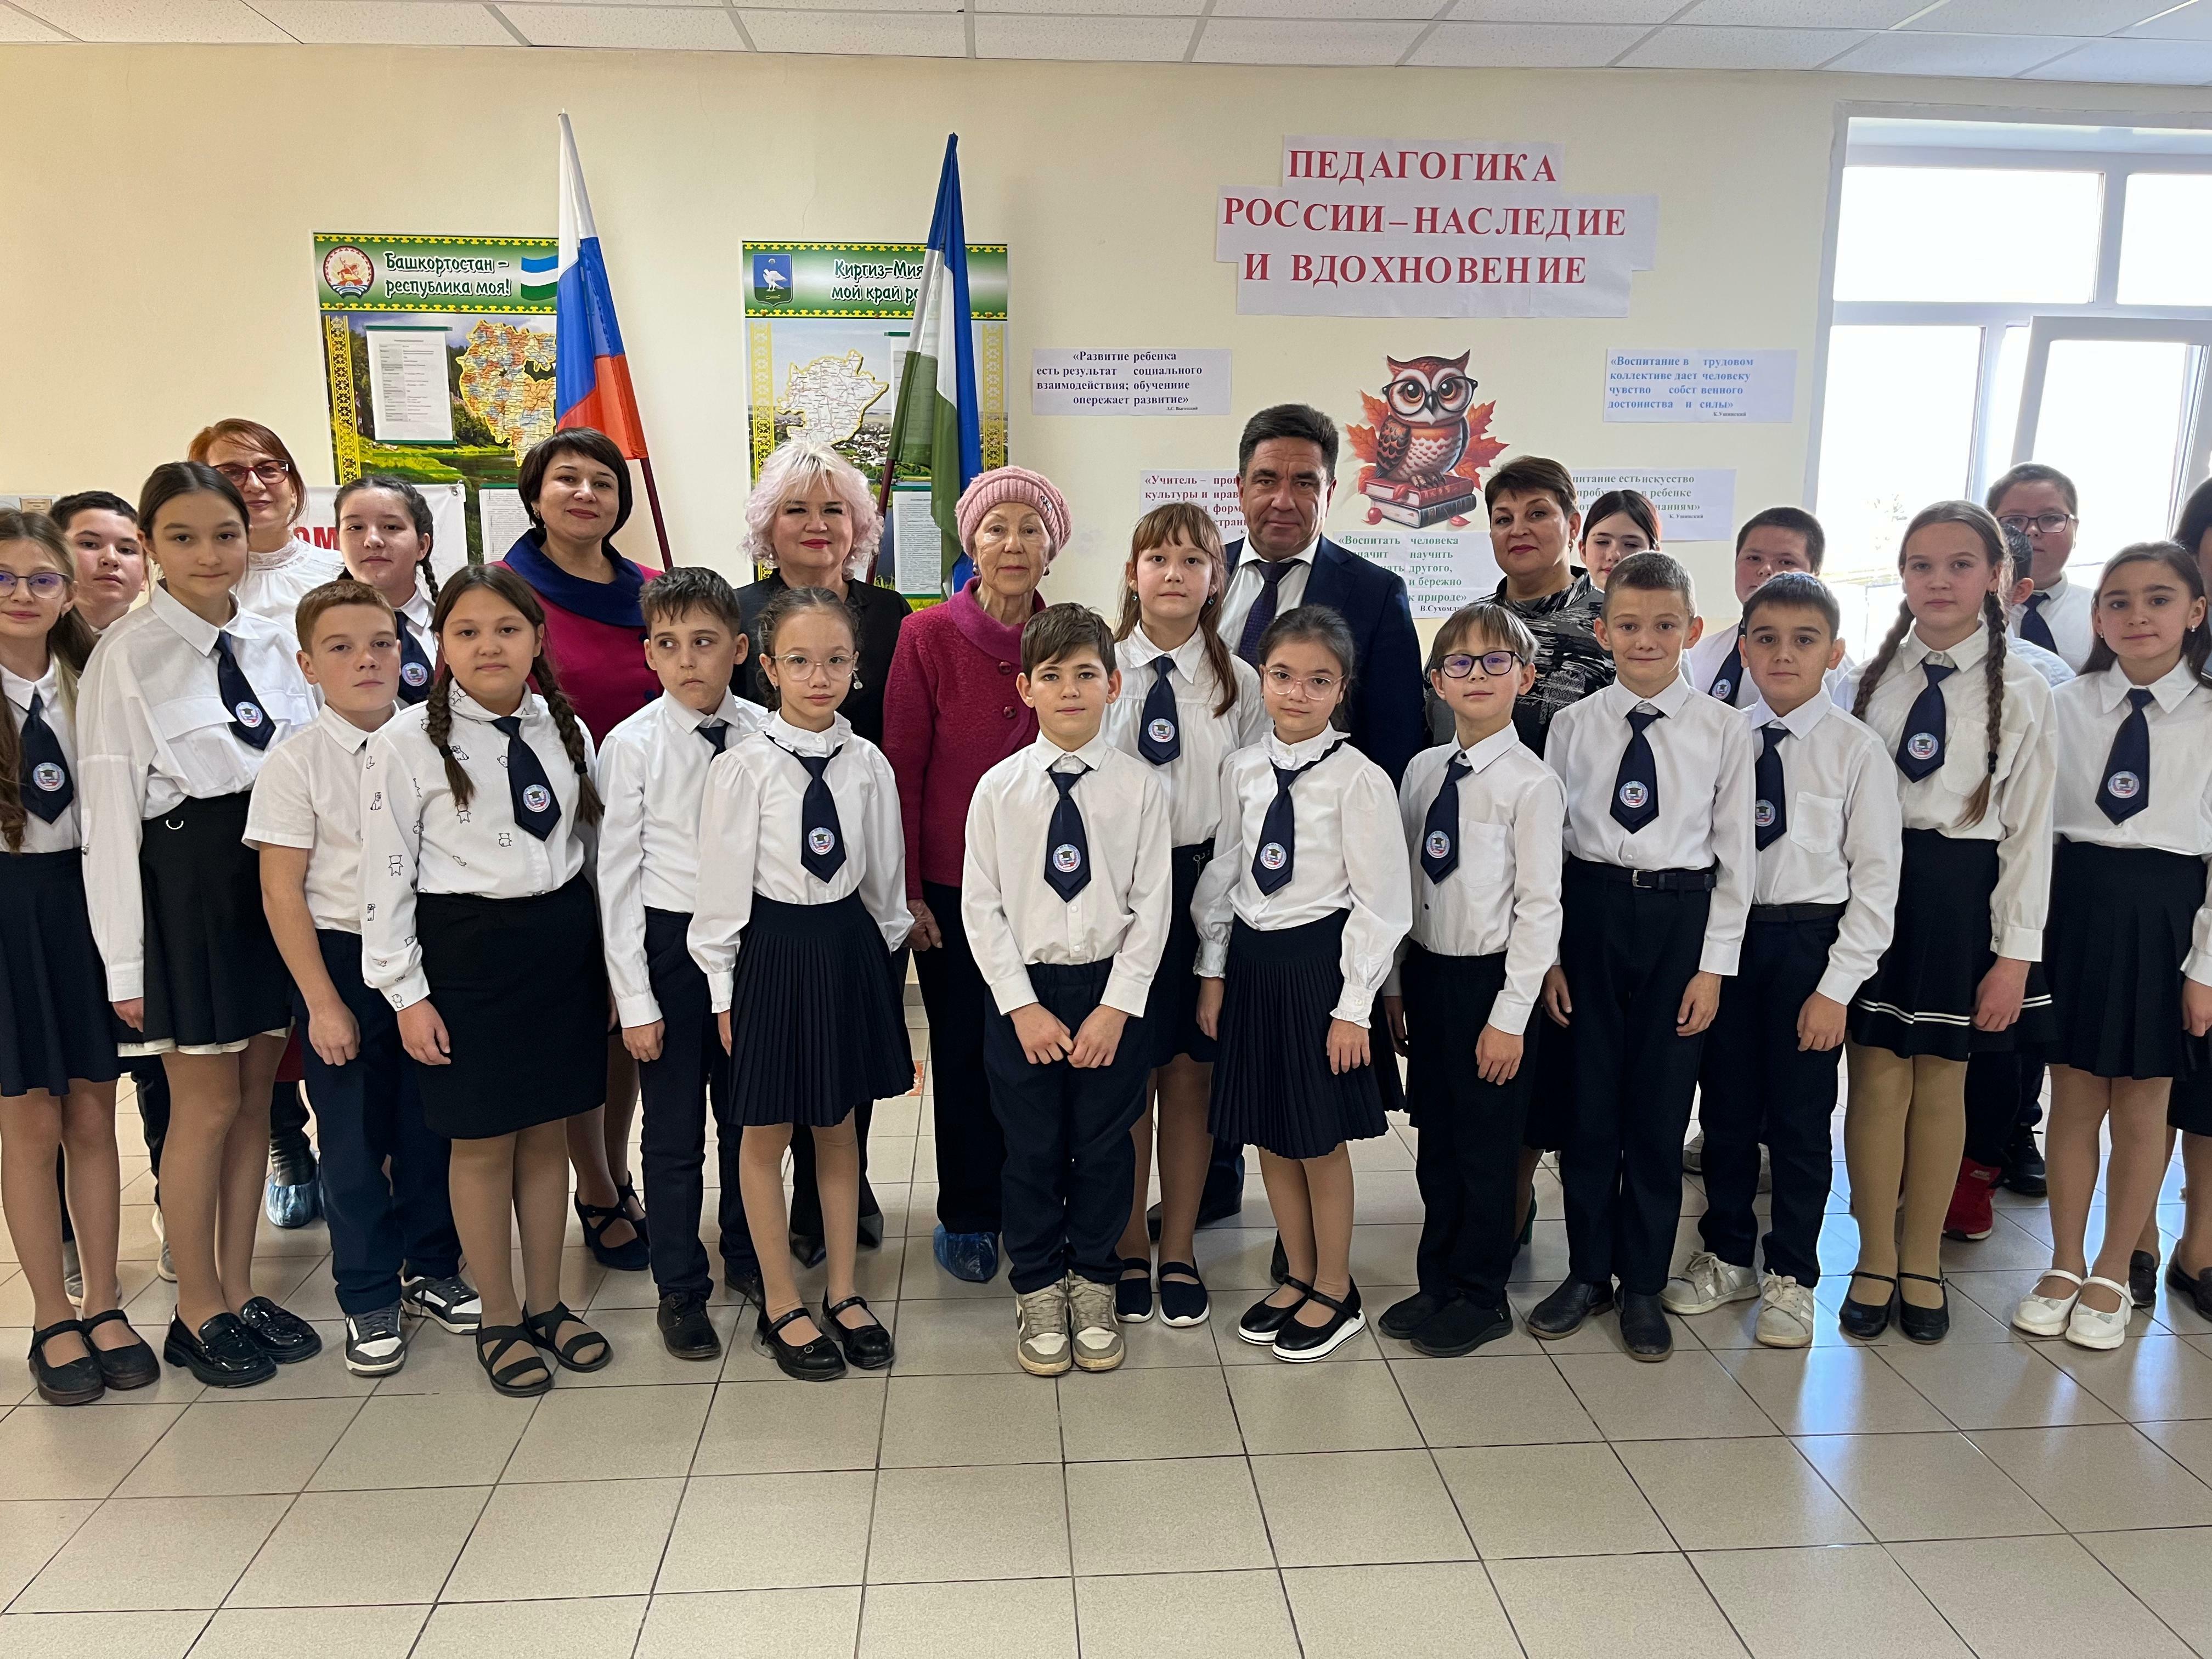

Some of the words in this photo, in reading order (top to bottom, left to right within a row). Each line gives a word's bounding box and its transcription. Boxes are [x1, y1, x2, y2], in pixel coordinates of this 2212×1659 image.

[1288, 150, 1557, 186] ПЕДАГОГИКА
[384, 252, 494, 275] Башкортостан
[1244, 253, 1271, 281] И
[1291, 254, 1587, 289] ВДОХНОВЕНИЕ
[385, 279, 472, 298] республика
[476, 278, 511, 295] моя!
[831, 285, 861, 300] мой
[866, 285, 901, 304] край
[1073, 351, 1129, 362] «Развитие
[1133, 351, 1177, 363] ребенка
[1611, 356, 1680, 366] «Воспитание
[1703, 359, 1753, 368] трудовом
[1063, 368, 1117, 377] результат
[1133, 367, 1203, 376] социального
[1674, 373, 1697, 381] дает
[1702, 373, 1751, 382] человеку
[1036, 380, 1129, 391] взаимодействия;
[1609, 387, 1651, 397] чувство
[1073, 396, 1129, 407] опережает
[1133, 396, 1189, 407] развитие»
[1145, 476, 1197, 485] «Учитель
[1145, 492, 1198, 501] культуры
[1214, 492, 1239, 500] нрав
[1577, 488, 1605, 499] пробу
[1650, 488, 1691, 499] ребенке
[1213, 504, 1241, 515] форм
[1339, 535, 1401, 545] «Воспитать
[1410, 551, 1453, 560] научить
[1408, 565, 1453, 574] другого,
[1418, 577, 1462, 588] бережно
[1418, 595, 1467, 603] природе»
